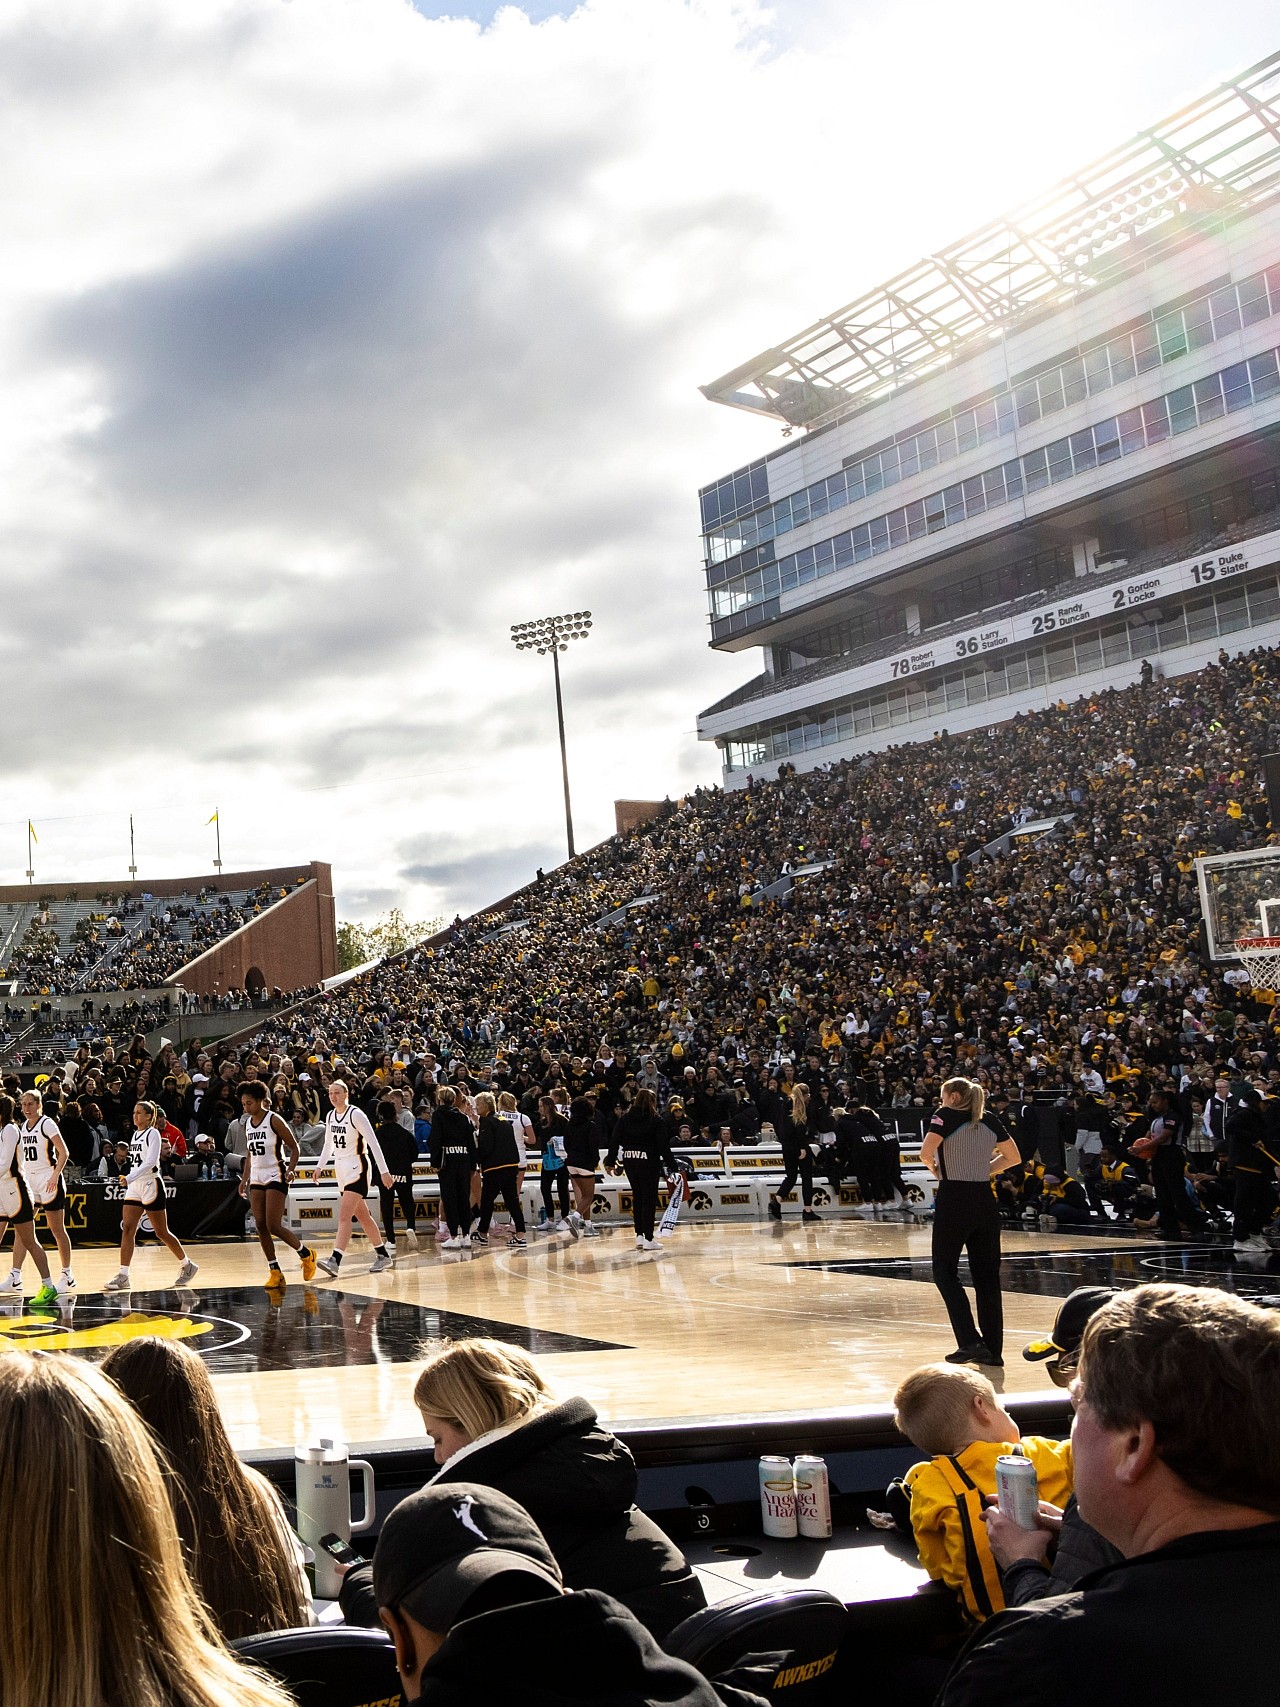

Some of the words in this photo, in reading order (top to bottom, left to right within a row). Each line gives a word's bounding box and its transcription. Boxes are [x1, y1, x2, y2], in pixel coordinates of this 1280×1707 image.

[1218, 553, 1243, 566] Duke
[1190, 560, 1216, 584] 15
[1220, 562, 1249, 576] Slater
[1128, 579, 1160, 594] Gordon
[1112, 590, 1126, 609] 2
[1128, 590, 1156, 604] Locke
[1058, 603, 1083, 617] Randy
[1032, 612, 1056, 635] 25
[1060, 612, 1090, 627] Duncan
[980, 630, 999, 641] Larry
[956, 636, 978, 656] 36
[982, 636, 1008, 650] Station
[910, 650, 934, 663] Robert
[890, 658, 910, 678] 78
[912, 659, 936, 672] Gallery
[248, 1132, 266, 1140] IOWA
[331, 1126, 346, 1134] IOWA
[23, 1136, 38, 1144] OWA
[333, 1135, 346, 1148] 44
[129, 1144, 142, 1152] OWA
[249, 1142, 266, 1156] 45
[446, 1146, 468, 1154] IOWA
[624, 1150, 648, 1159] IOWA
[797, 1493, 816, 1508] gel
